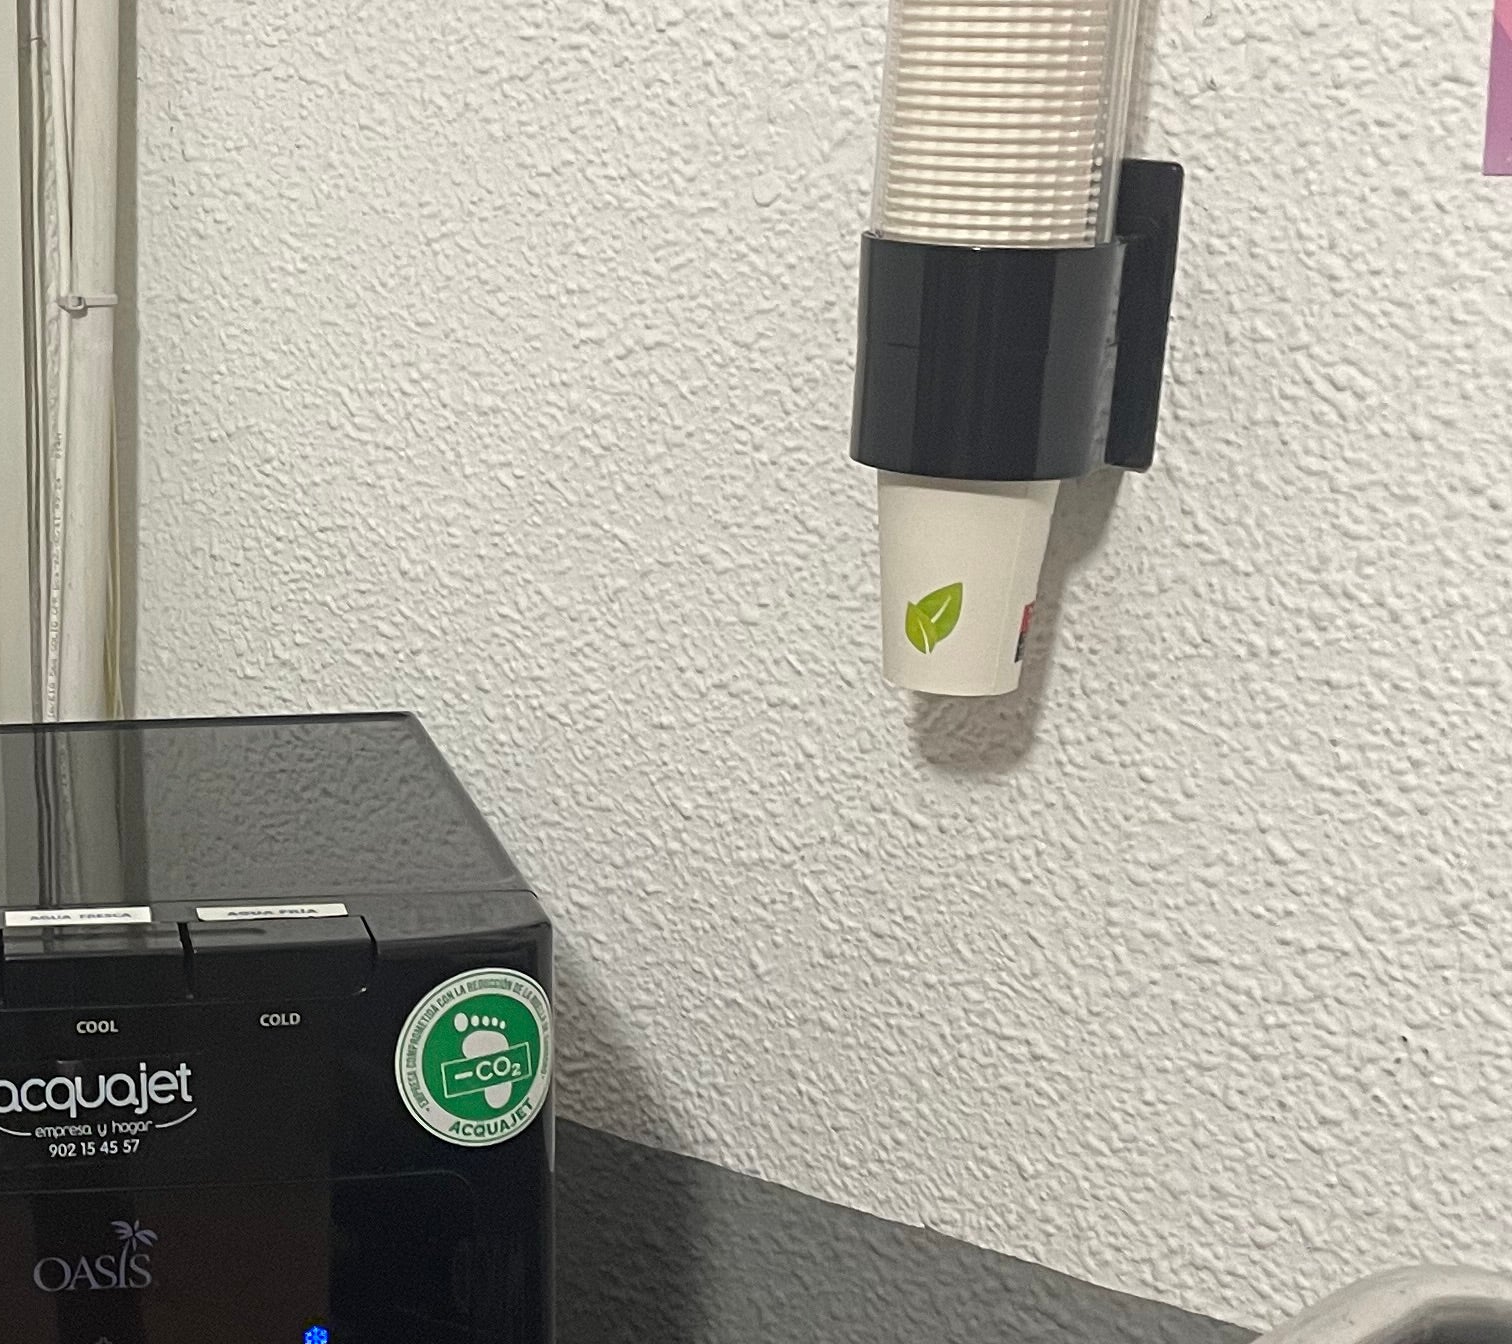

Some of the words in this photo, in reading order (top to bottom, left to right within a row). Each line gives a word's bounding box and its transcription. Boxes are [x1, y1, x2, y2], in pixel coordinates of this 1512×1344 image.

[29, 914, 72, 922] AGUA
[79, 911, 133, 920] FRESCA
[76, 1020, 119, 1035] COOL
[259, 1012, 301, 1027] COLD
[449, 1097, 534, 1137] ACQUAJET
[35, 1122, 93, 1138] empresa
[96, 1122, 108, 1137] y
[111, 1118, 153, 1136] hogar
[48, 1143, 76, 1158] 902
[79, 1142, 96, 1156] 15
[100, 1140, 119, 1155] 45
[122, 1139, 140, 1154] 57
[33, 1239, 153, 1293] OASIS
